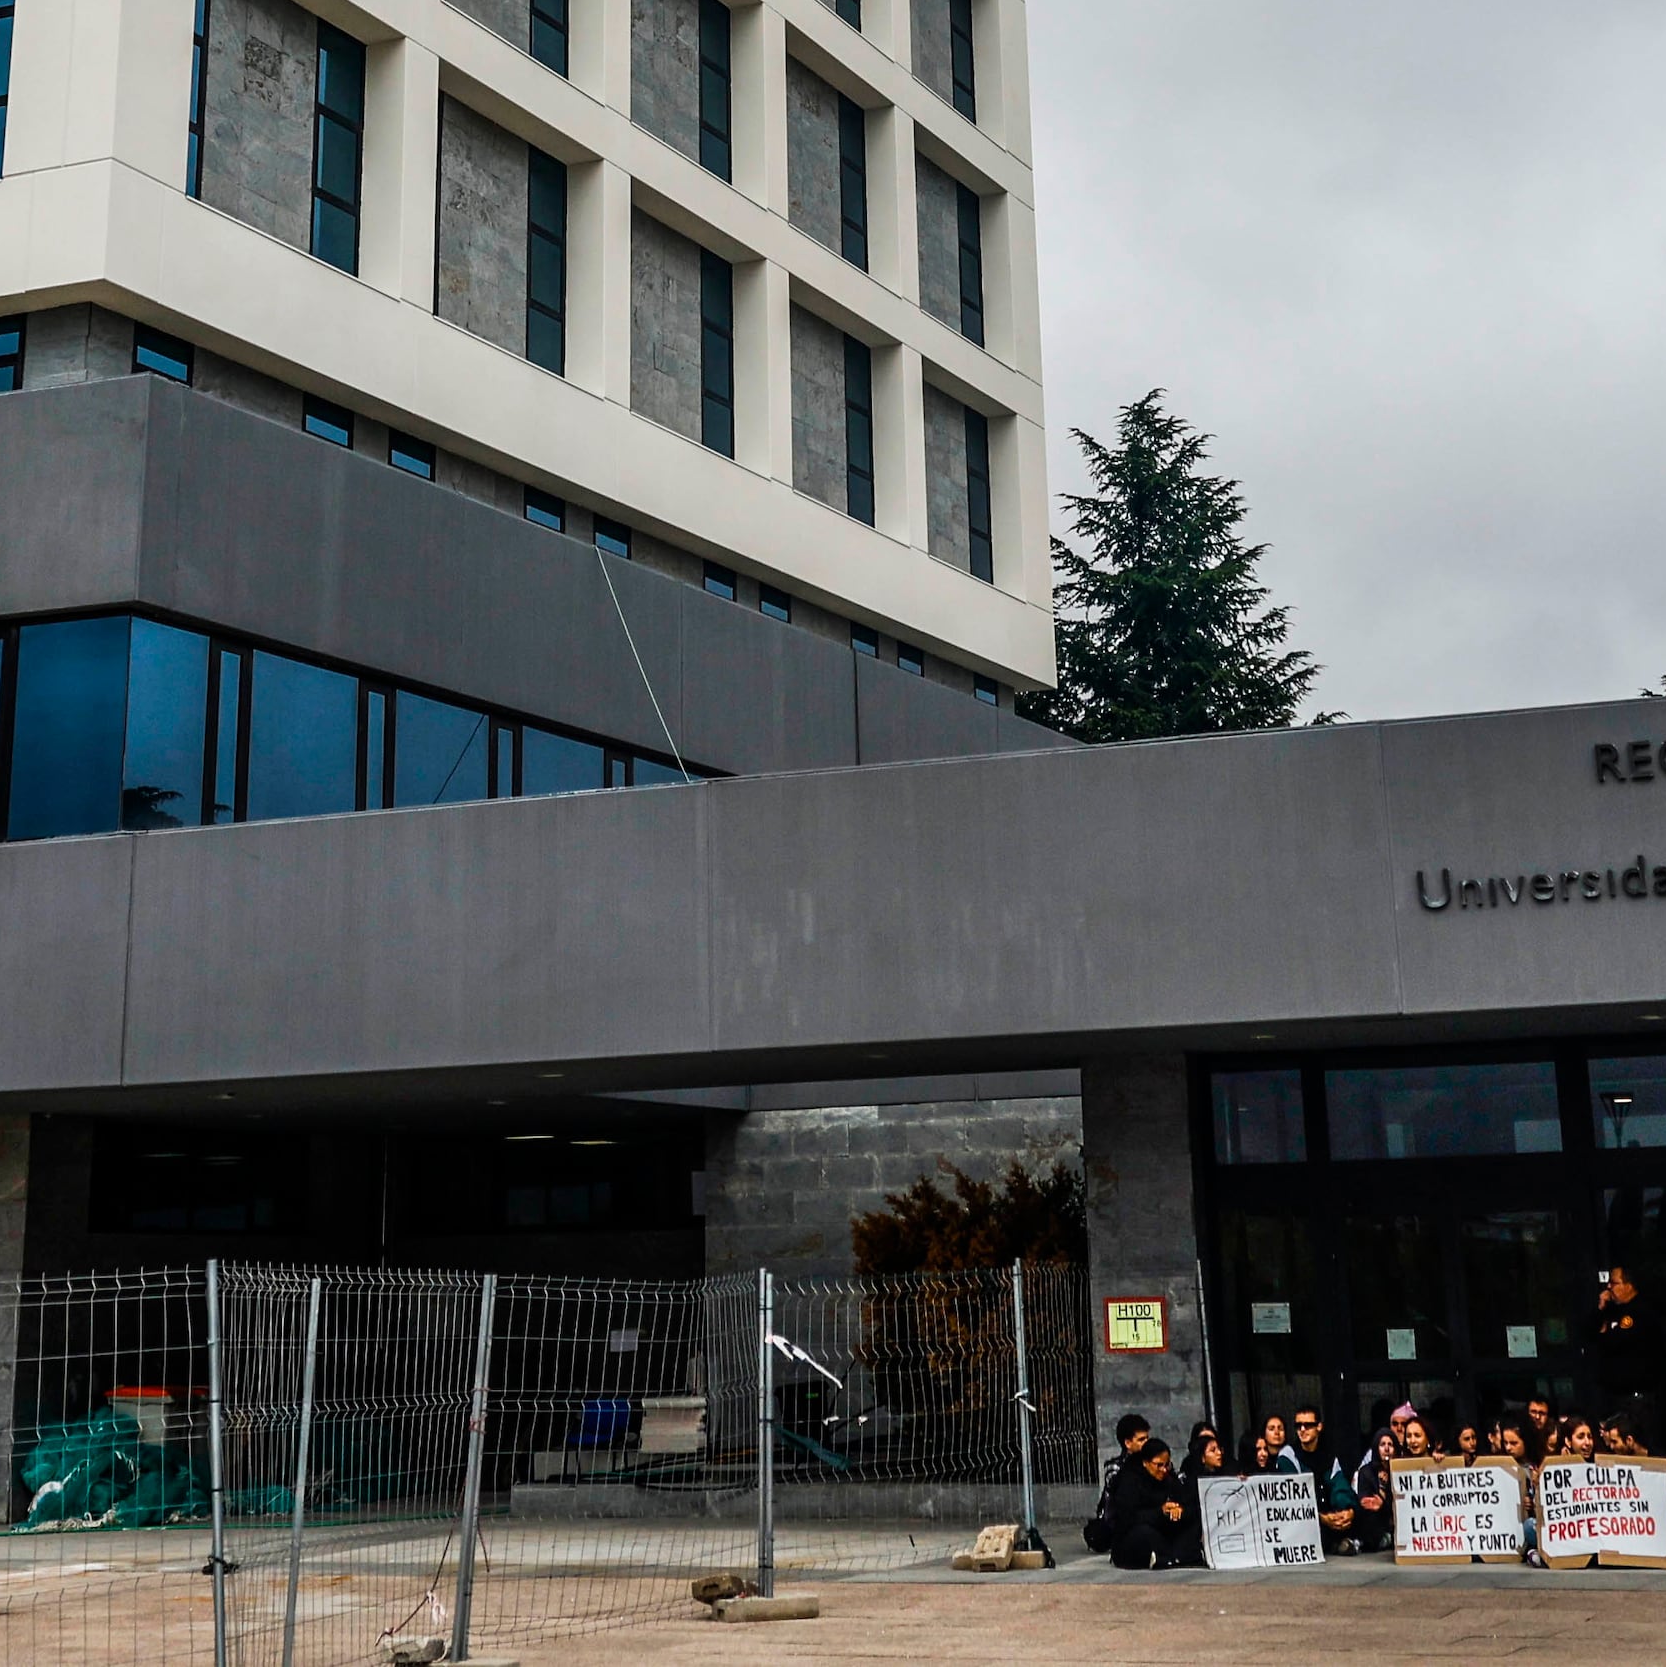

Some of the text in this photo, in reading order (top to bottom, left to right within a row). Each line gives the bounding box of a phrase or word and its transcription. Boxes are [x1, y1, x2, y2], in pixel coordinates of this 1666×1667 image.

[1118, 1304, 1151, 1317] H100
[1398, 1470, 1494, 1492] NI PA BUITRES
[1543, 1467, 1636, 1491] POR CULPA
[1258, 1479, 1311, 1501] NUESTRA
[1545, 1486, 1641, 1507] DEL RECTORADO
[1411, 1491, 1500, 1510] NI CORRUPTOS
[1547, 1500, 1650, 1521] ESTUDIANTES SIN
[1216, 1509, 1242, 1527] RIP
[1411, 1516, 1428, 1534] LA
[1475, 1514, 1494, 1529] ES
[1265, 1527, 1282, 1543] SE
[1548, 1516, 1656, 1542] PROFESORADO
[1412, 1533, 1517, 1552] NUESTRA Y PUNTO
[1273, 1545, 1318, 1564] MUERE
